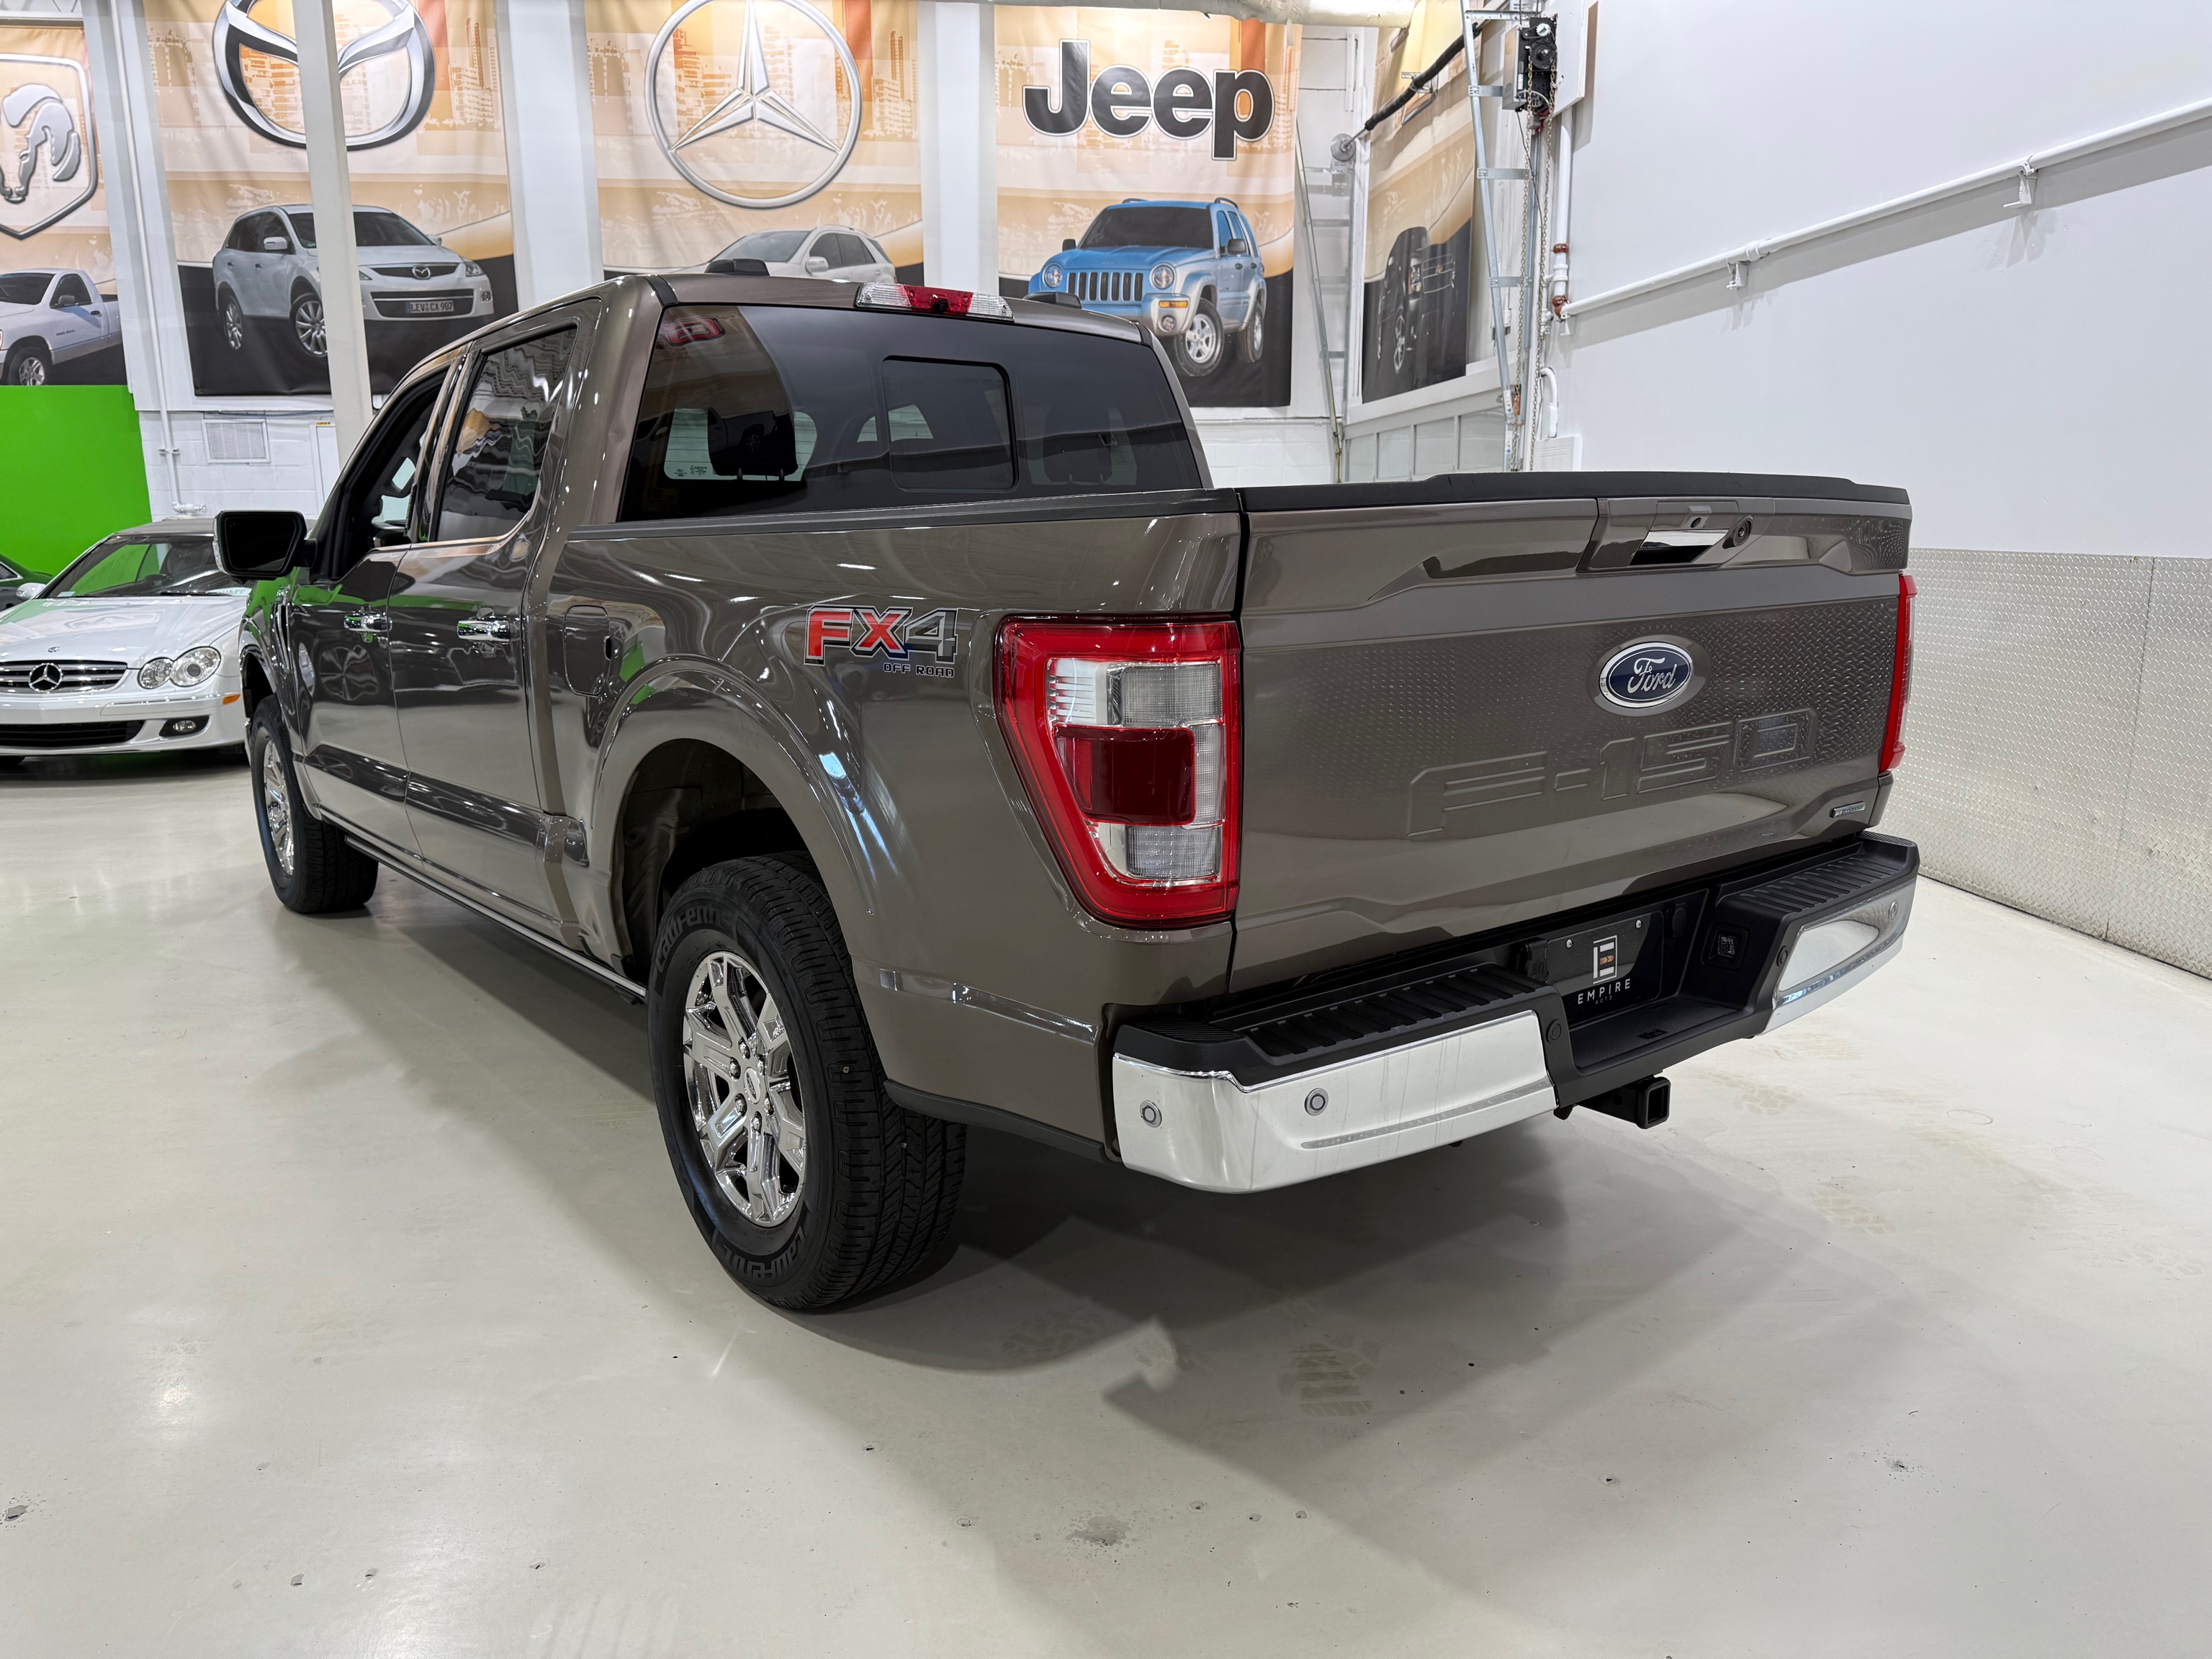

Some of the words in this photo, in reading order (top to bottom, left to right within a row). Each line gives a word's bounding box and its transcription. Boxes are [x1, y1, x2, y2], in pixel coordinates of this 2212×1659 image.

[1022, 37, 1276, 161] Jeep
[804, 603, 958, 667] FX4
[883, 662, 911, 674] OFF
[915, 665, 955, 678] ROAD
[1626, 657, 1678, 693] Ford
[1407, 708, 1817, 837] F-150
[1577, 978, 1631, 1005] EMPIRE
[1595, 995, 1613, 1004] AUTO
